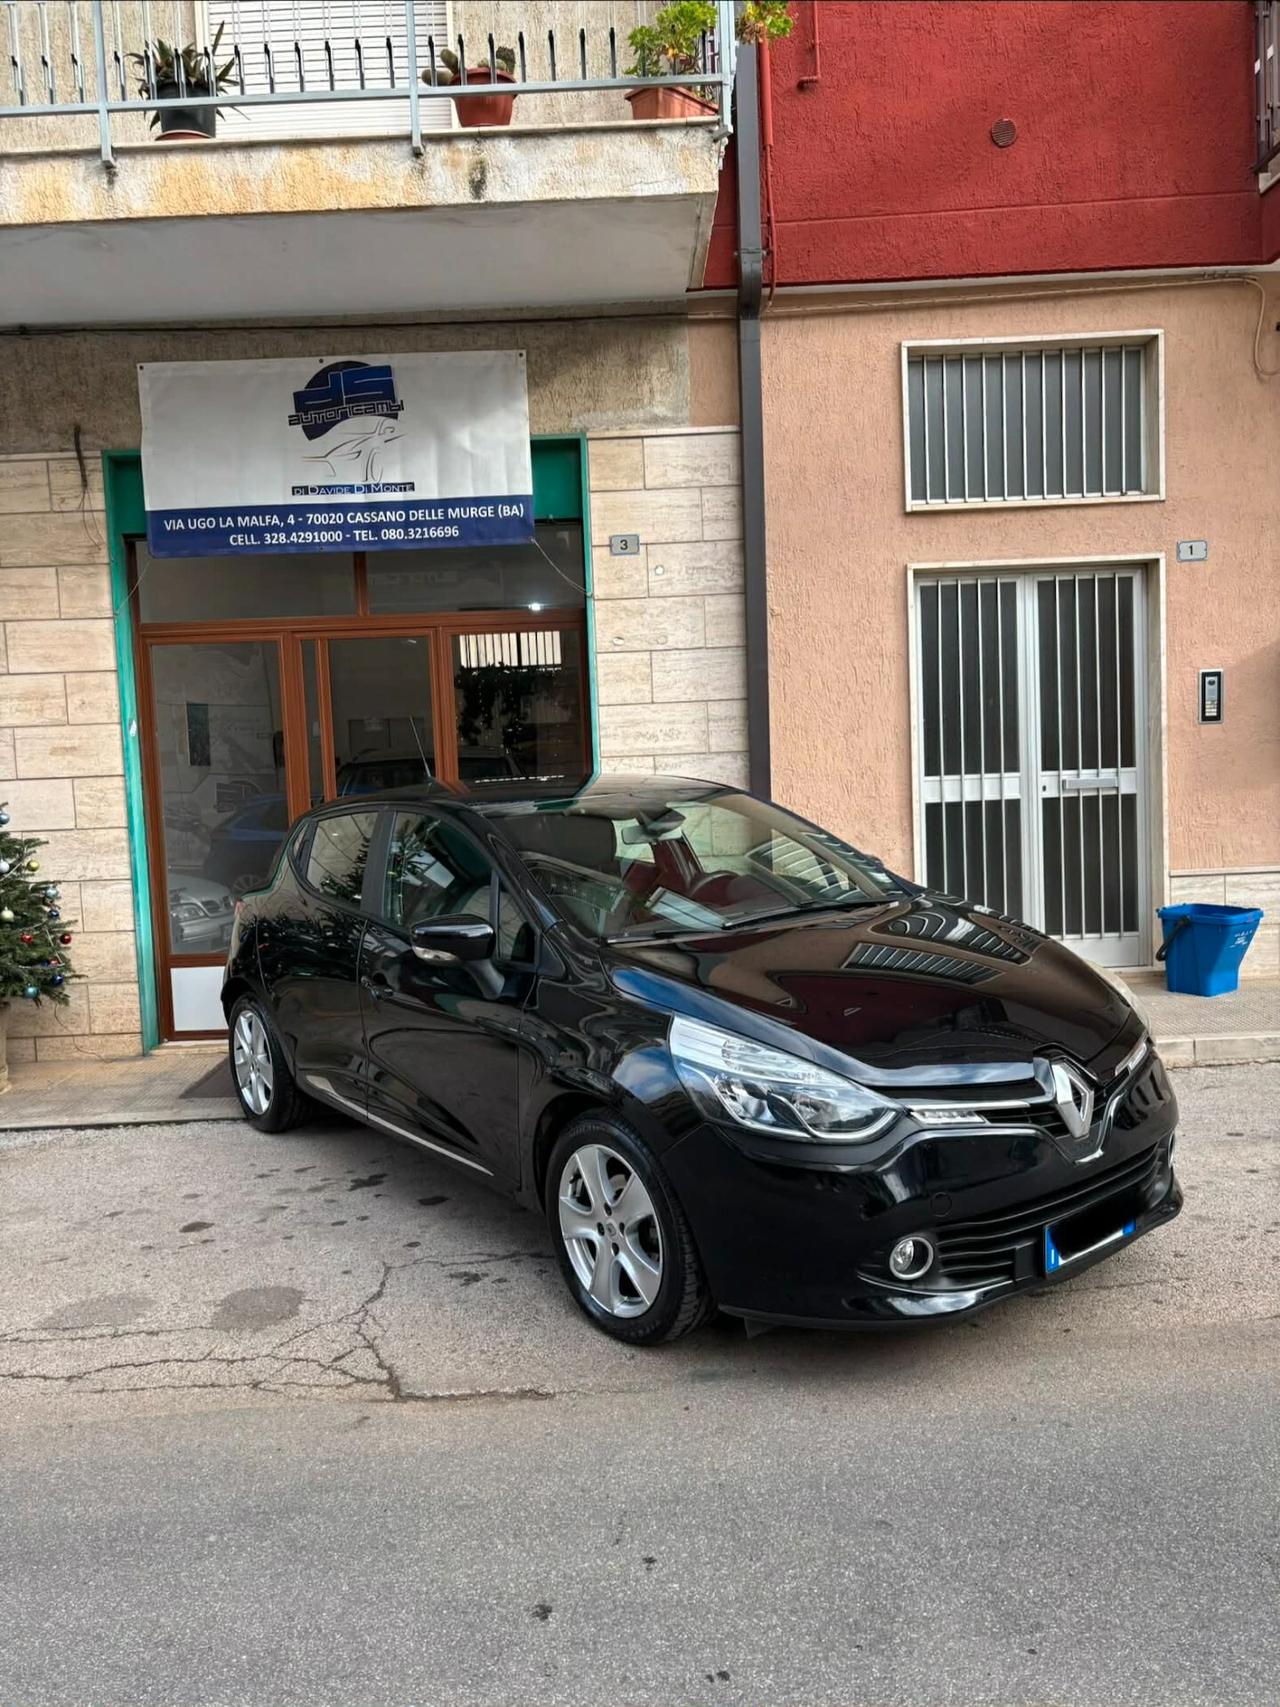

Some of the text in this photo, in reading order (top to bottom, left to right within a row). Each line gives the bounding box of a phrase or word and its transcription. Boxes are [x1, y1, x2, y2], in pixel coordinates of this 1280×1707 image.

[308, 484, 352, 496] DAVIDE
[370, 482, 414, 494] MONTE
[164, 518, 185, 531] VIA
[187, 517, 216, 530] UGO
[219, 516, 235, 528] LA
[237, 514, 284, 528] MALFA,
[286, 513, 296, 525] 4
[306, 511, 344, 525] 70020
[346, 509, 406, 524] CASSANO
[408, 507, 445, 521] DELLE
[447, 505, 495, 519] MURGE
[497, 503, 525, 519] (BA)
[229, 533, 261, 546] CELL.
[263, 530, 344, 545] 328.4291000
[353, 529, 378, 542] TEL.
[380, 524, 460, 541] 080.3216696
[619, 538, 628, 551] 3
[1188, 544, 1194, 556] 1
